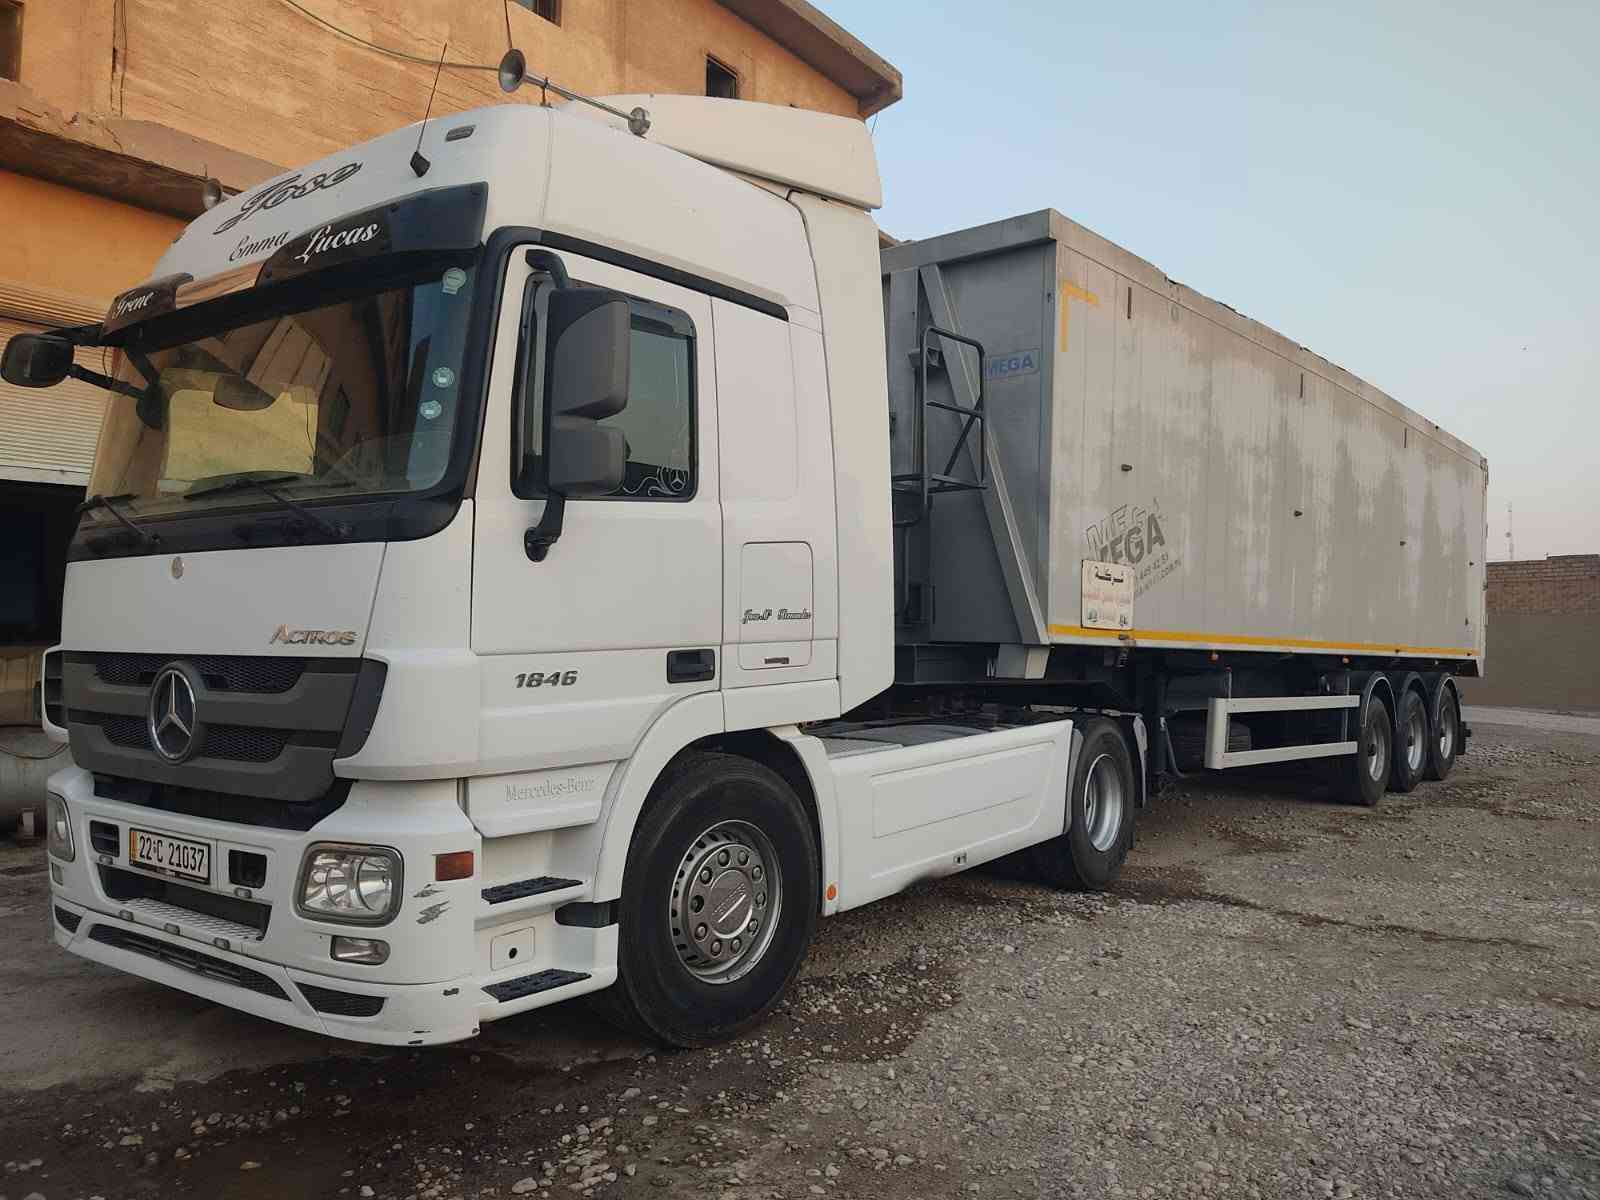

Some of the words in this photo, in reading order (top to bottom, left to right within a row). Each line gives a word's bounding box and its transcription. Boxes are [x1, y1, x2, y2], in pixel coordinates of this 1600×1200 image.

[213, 162, 362, 235] Jose
[229, 231, 289, 261] Emma
[295, 223, 379, 264] Lucas
[514, 670, 578, 689] 1846
[168, 842, 205, 872] 21037
